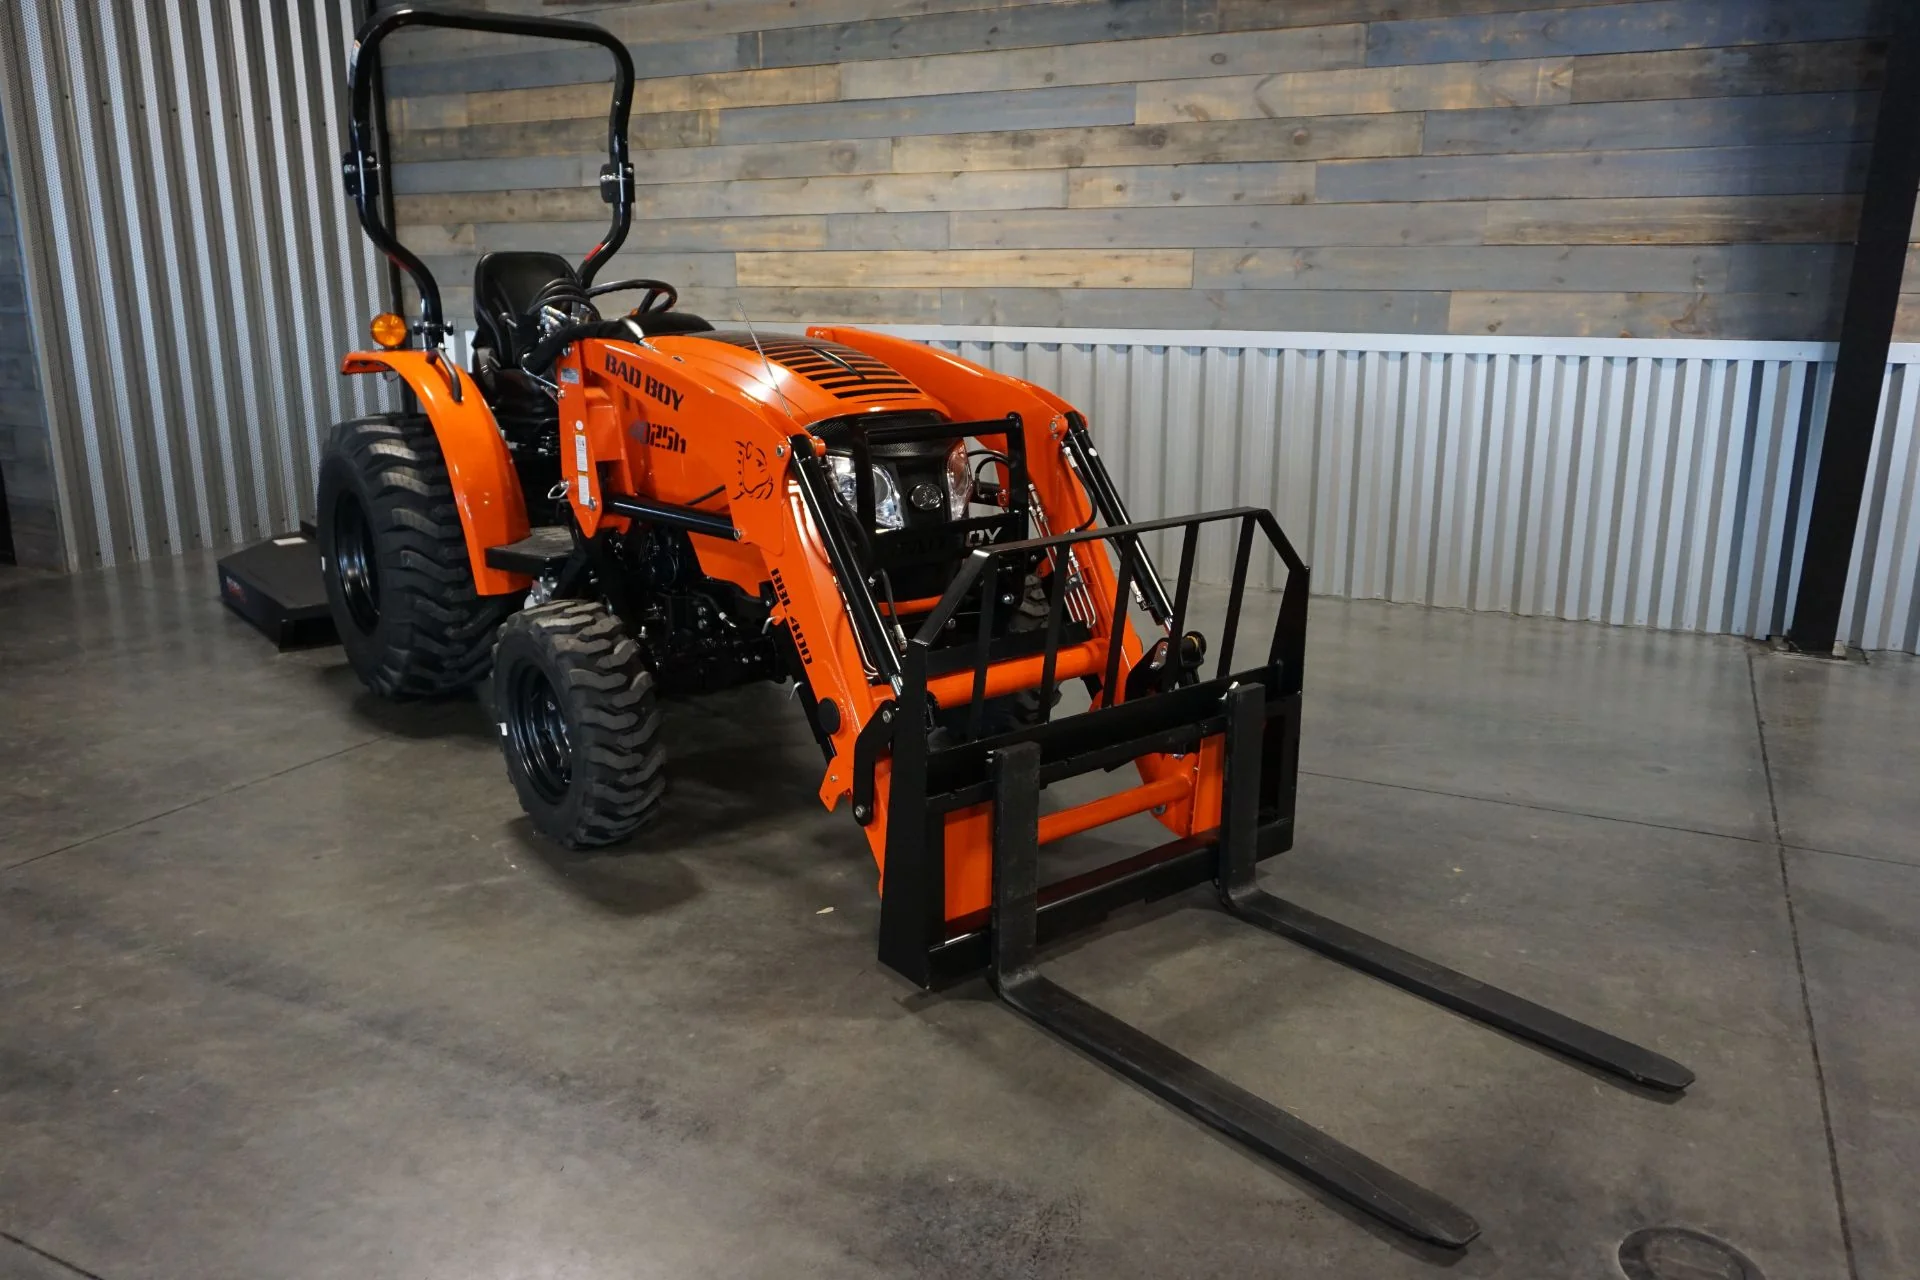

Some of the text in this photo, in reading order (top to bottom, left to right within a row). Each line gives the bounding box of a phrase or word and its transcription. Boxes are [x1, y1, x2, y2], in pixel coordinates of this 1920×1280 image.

[605, 352, 641, 389] BAD
[645, 375, 684, 412] BOY
[955, 527, 1002, 548] OY
[789, 615, 813, 665] 400
